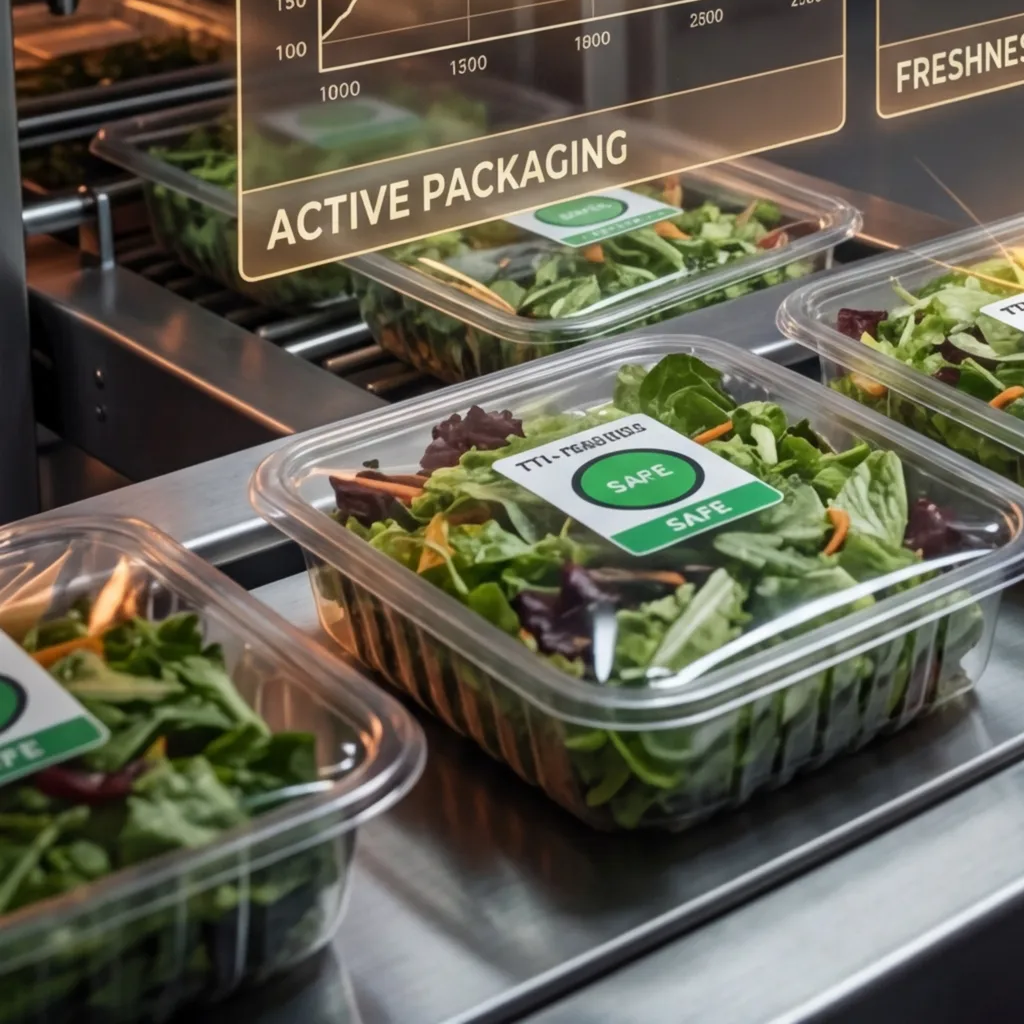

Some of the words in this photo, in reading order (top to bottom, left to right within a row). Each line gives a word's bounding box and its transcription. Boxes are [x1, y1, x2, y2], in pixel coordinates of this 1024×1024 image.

[275, 41, 308, 62] 100
[319, 80, 361, 103] 1000
[266, 179, 410, 251] ACTIVE
[423, 129, 628, 212] PACKAGING
[665, 499, 733, 533] SAFE
